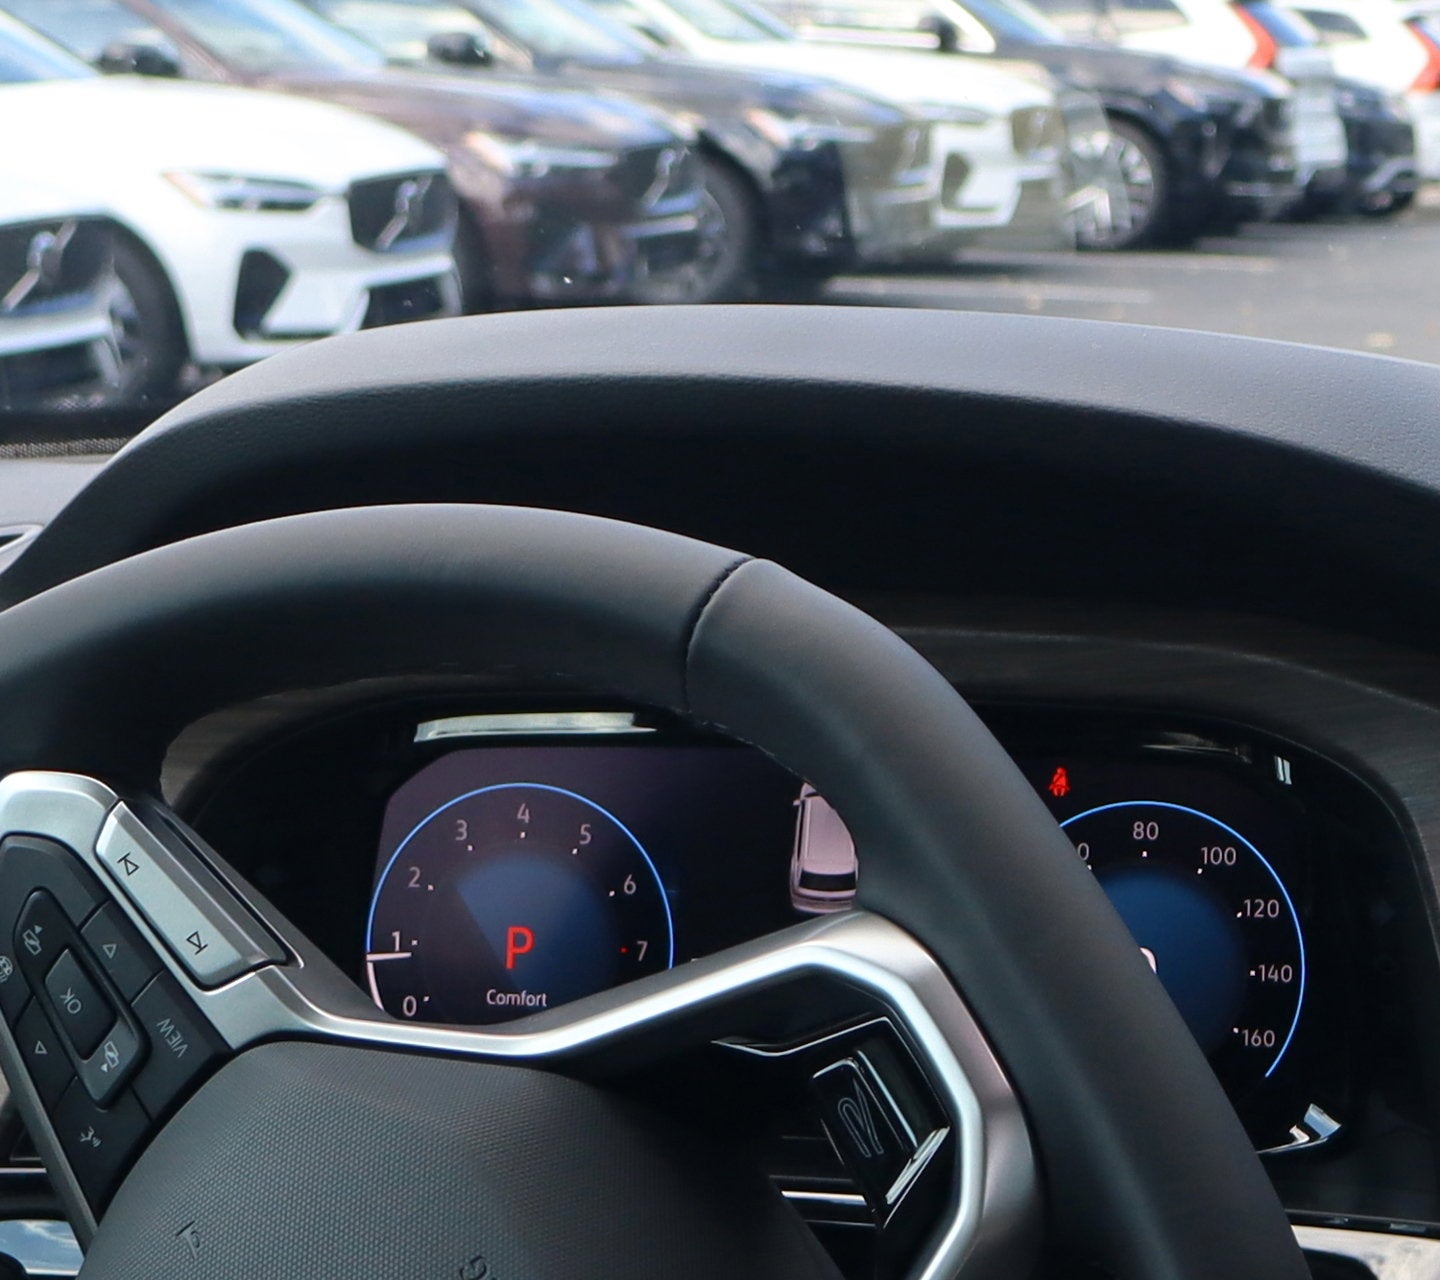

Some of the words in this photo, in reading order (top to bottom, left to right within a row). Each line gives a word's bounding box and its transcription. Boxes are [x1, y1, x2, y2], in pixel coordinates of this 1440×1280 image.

[516, 803, 530, 824] 4
[455, 819, 468, 841] 3
[579, 823, 592, 845] 5
[1132, 821, 1159, 841] 80
[1076, 841, 1091, 862] 0
[1199, 845, 1238, 866] 100
[408, 866, 421, 888] 2
[623, 874, 637, 895] 6
[1244, 898, 1280, 918] 120
[389, 930, 403, 953] 1
[505, 925, 534, 969] P
[636, 940, 648, 962] 7
[1259, 964, 1293, 983] 140
[59, 987, 82, 1014] OK
[402, 995, 417, 1017] 0
[485, 987, 548, 1009] Comfort
[156, 1018, 188, 1058] VIEW
[1242, 1029, 1276, 1048] 160
